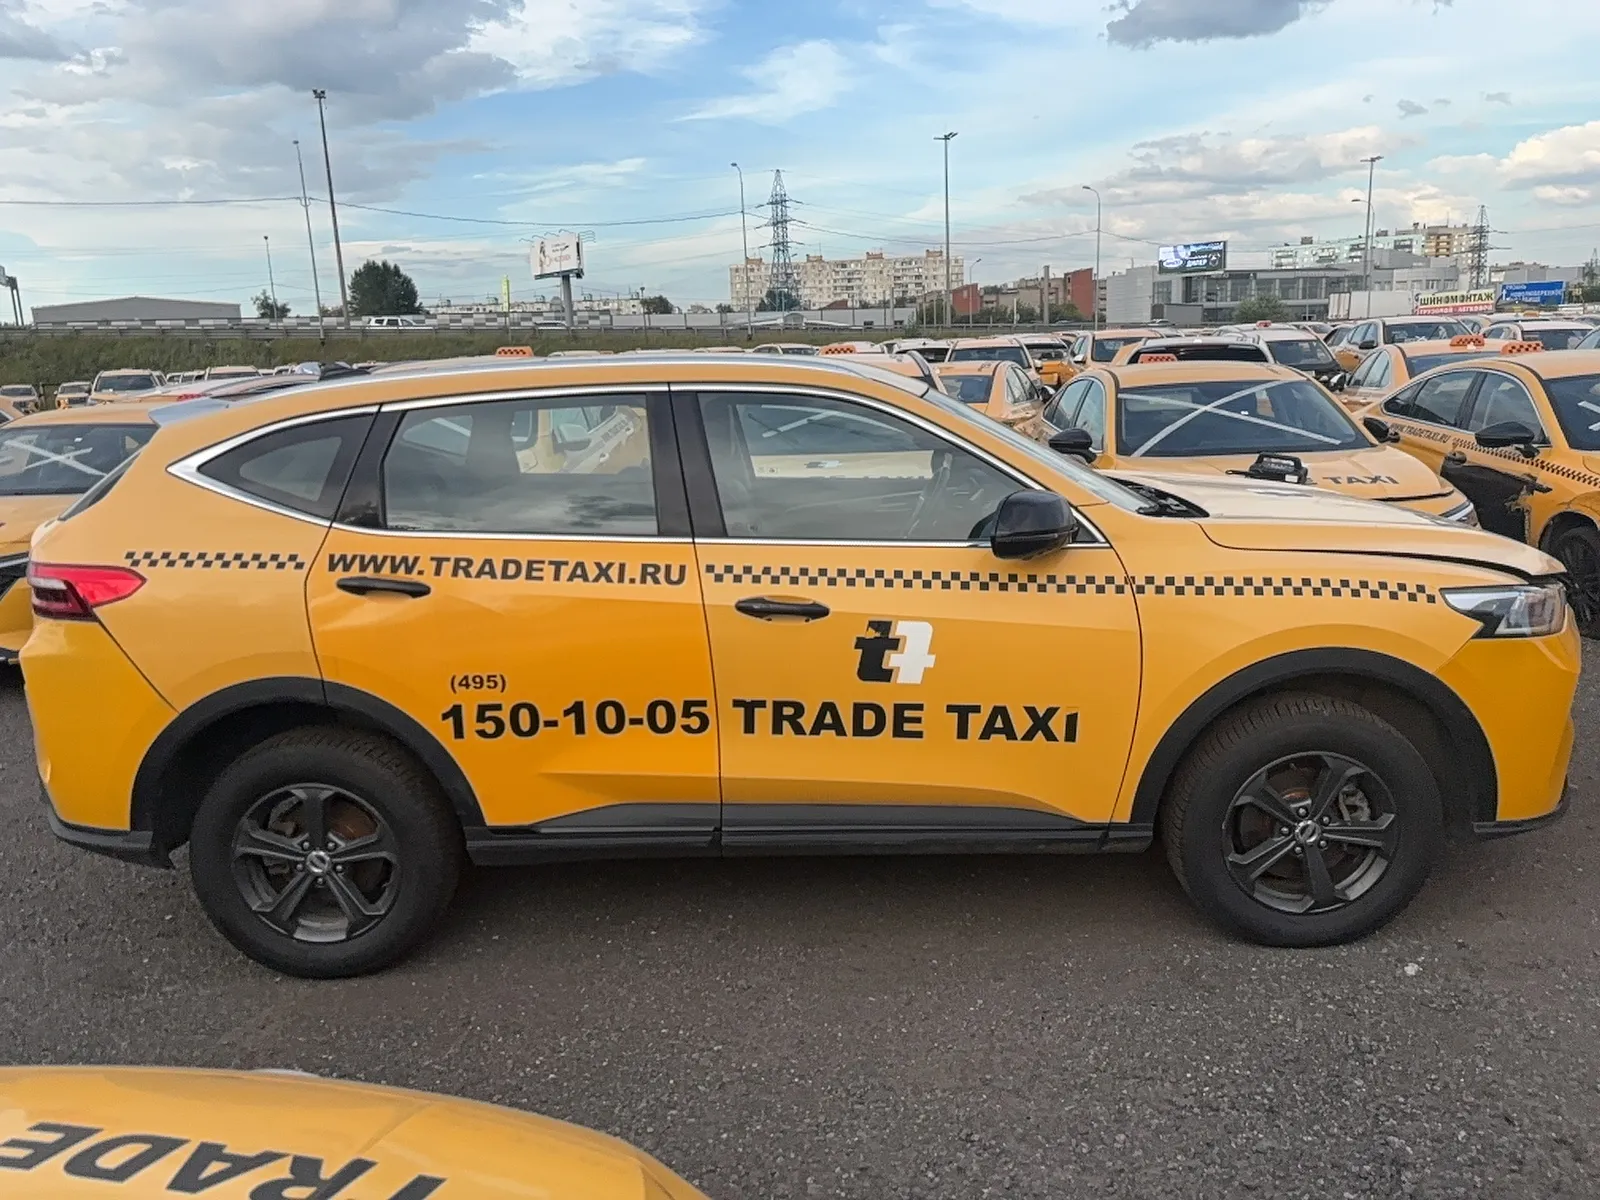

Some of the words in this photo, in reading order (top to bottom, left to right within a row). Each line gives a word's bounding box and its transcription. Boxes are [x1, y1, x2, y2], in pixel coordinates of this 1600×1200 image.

[1420, 292, 1494, 306] ШИНОМОНТАЖ
[1322, 475, 1400, 485] TAXI
[328, 553, 687, 585] WWW.TRADETAXI.RU
[450, 674, 507, 693] (495)
[441, 699, 709, 740] 150-10-05
[732, 698, 924, 739] TRADE
[946, 704, 1079, 743] TAXI
